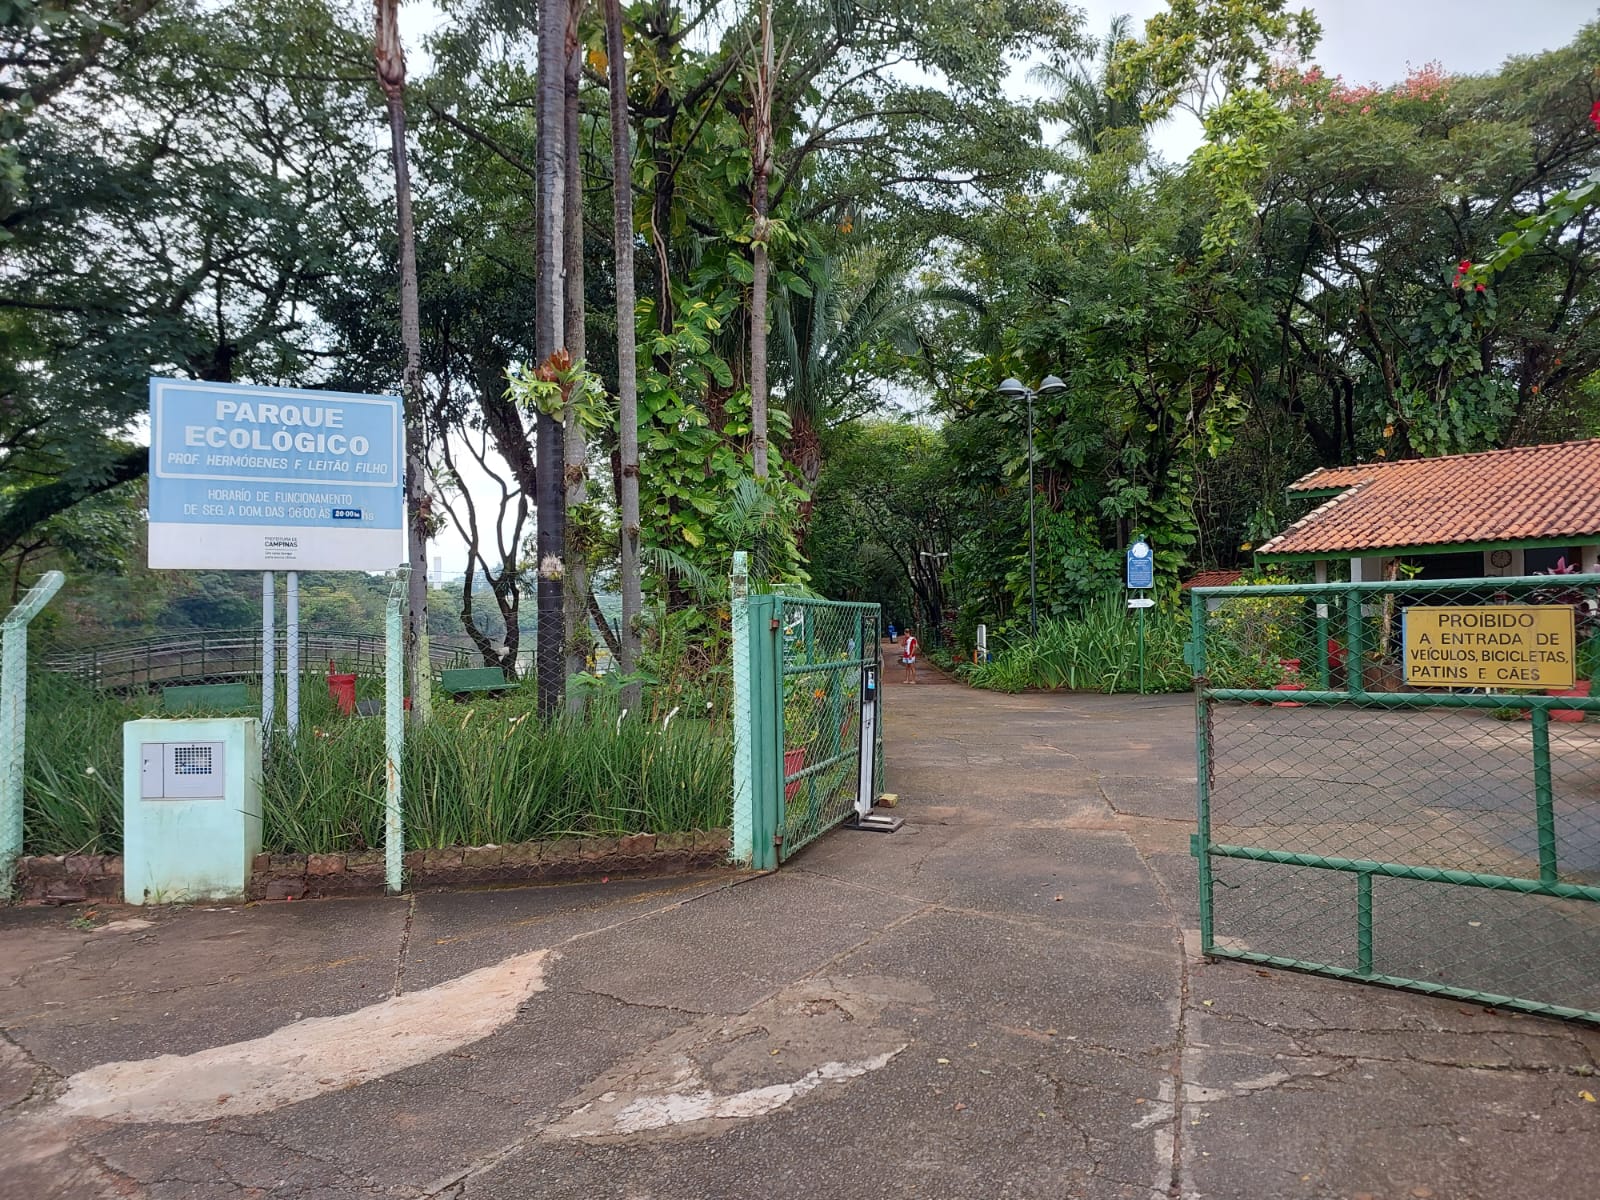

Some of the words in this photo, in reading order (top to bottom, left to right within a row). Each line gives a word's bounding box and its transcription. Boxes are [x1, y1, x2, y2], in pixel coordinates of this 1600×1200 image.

[216, 399, 344, 428] PARQUE
[184, 424, 370, 456] ECOLÓGICO
[206, 454, 288, 470] HERMÓGENES
[308, 460, 349, 472] LEITÃO
[355, 462, 388, 475] FILHO
[256, 491, 271, 502] DE
[275, 491, 353, 506] FUNCIONAMENTO
[183, 503, 198, 515] DE
[228, 504, 236, 516] A
[265, 506, 285, 518] DAS
[1419, 633, 1431, 645] A
[1441, 632, 1523, 646] ENTRADA
[1536, 632, 1560, 646] DE
[1410, 646, 1479, 663] VEÍCULOS,
[1481, 650, 1569, 664] BICICLETAS,
[1411, 665, 1468, 679] PATINS
[1478, 667, 1487, 680] E
[1496, 666, 1540, 681] CÃES
